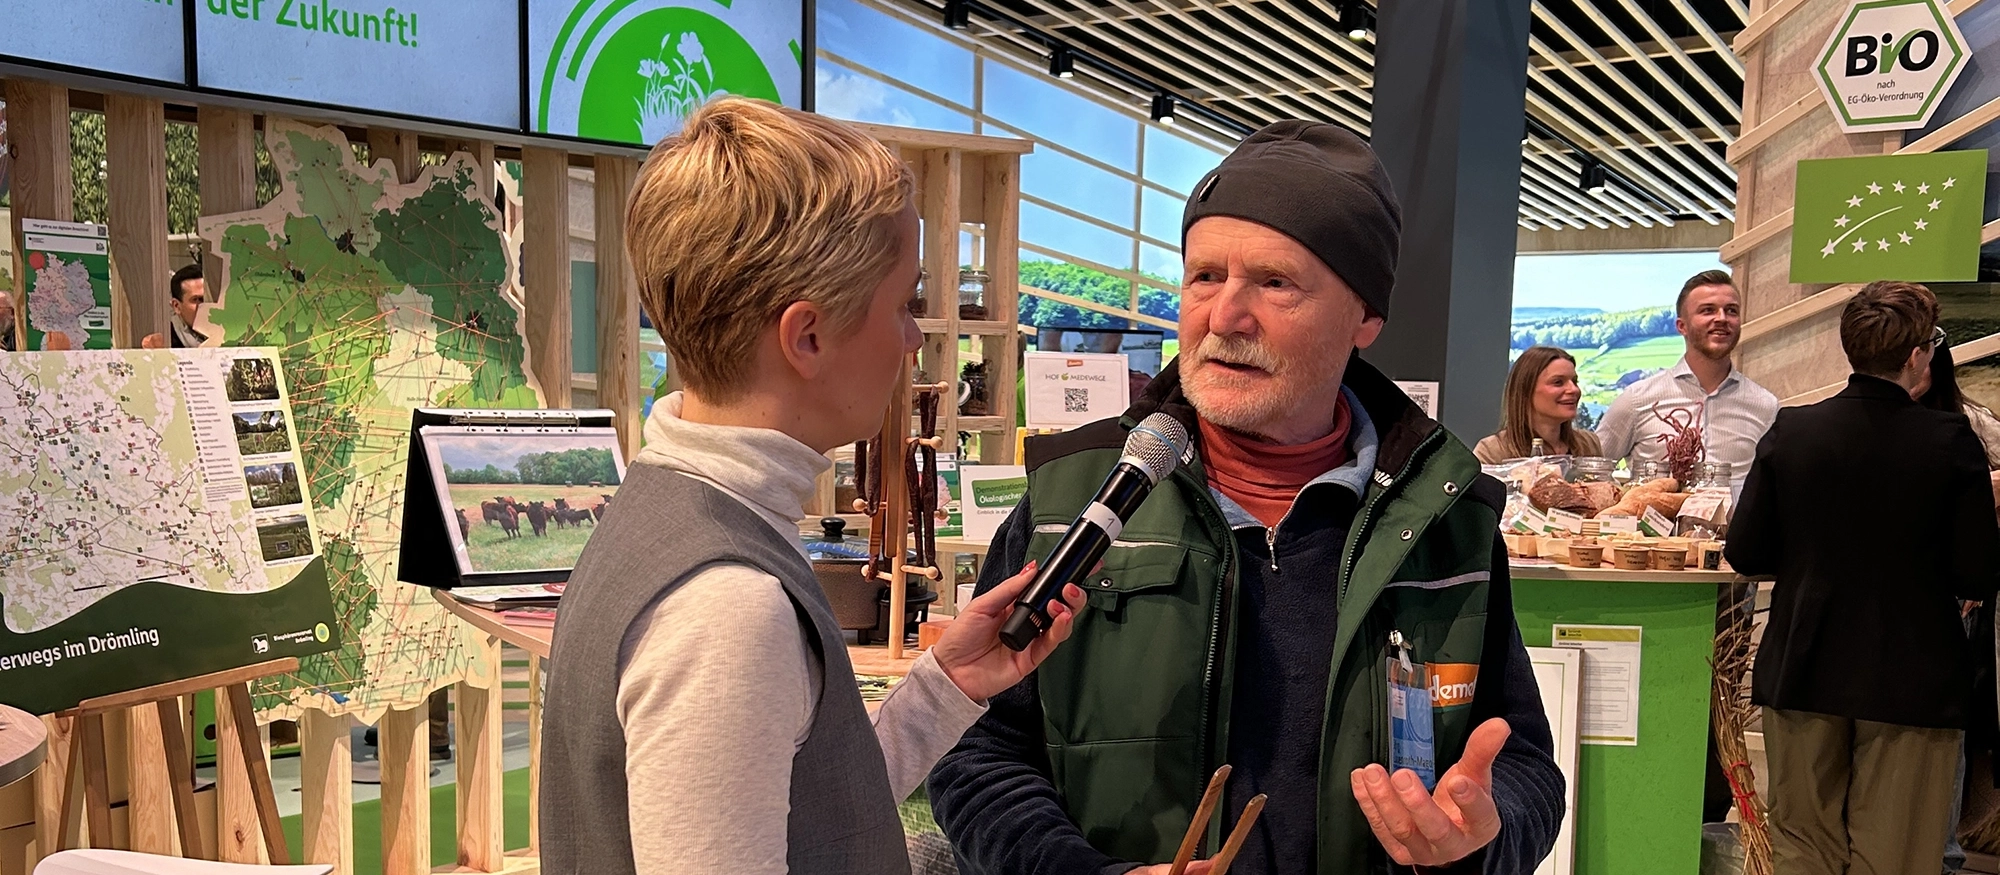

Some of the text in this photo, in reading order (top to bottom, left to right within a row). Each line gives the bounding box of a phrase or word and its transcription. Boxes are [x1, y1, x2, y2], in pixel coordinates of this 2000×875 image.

[276, 0, 418, 48] Zukunft!
[1877, 79, 1896, 89] nach
[1847, 90, 1925, 105] EG-Öko-Verordnung
[1070, 374, 1106, 382] MEDEWEGE
[0, 628, 160, 672] erwegs im Drömling
